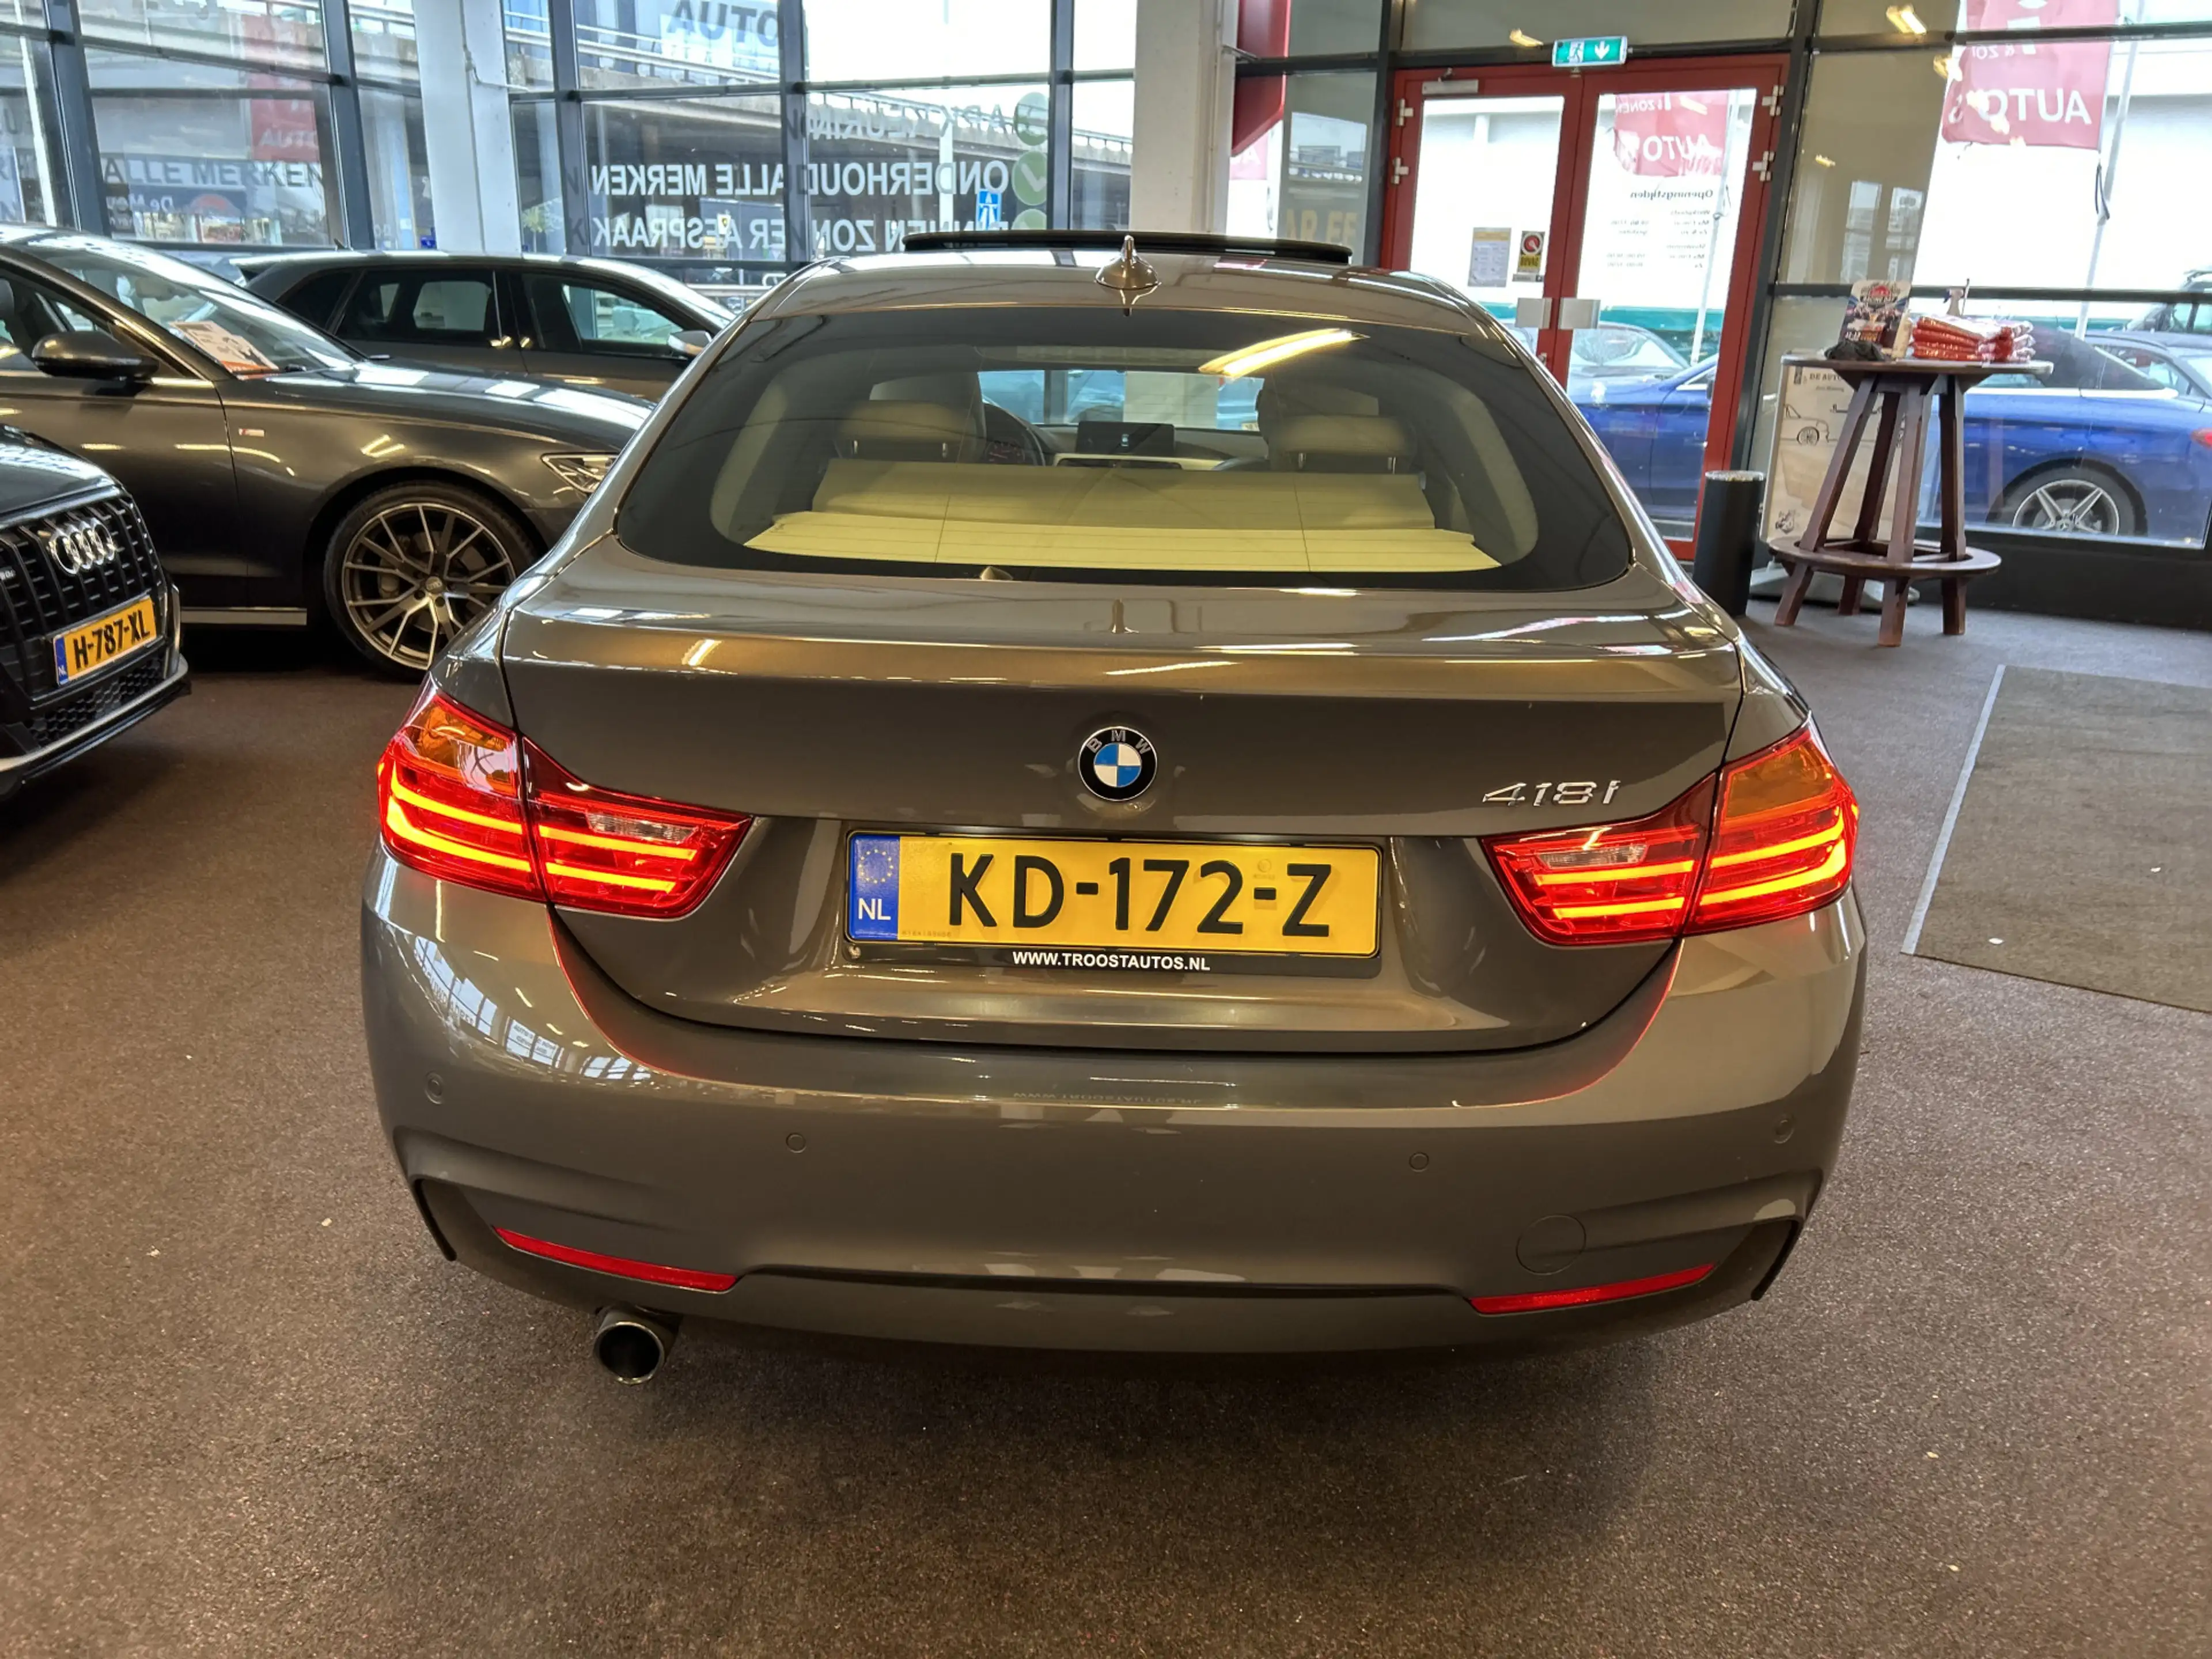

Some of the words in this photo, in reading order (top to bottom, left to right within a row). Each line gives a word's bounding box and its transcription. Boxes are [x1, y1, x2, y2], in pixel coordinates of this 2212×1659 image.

[73, 609, 150, 670] H-787-XL
[1086, 729, 1152, 755] BMW
[1482, 779, 1621, 807] 418i
[948, 851, 1332, 938] KD-172-Z
[858, 899, 892, 921] NL
[1012, 950, 1211, 972] WWW.TROOSTAUTOS.NL
